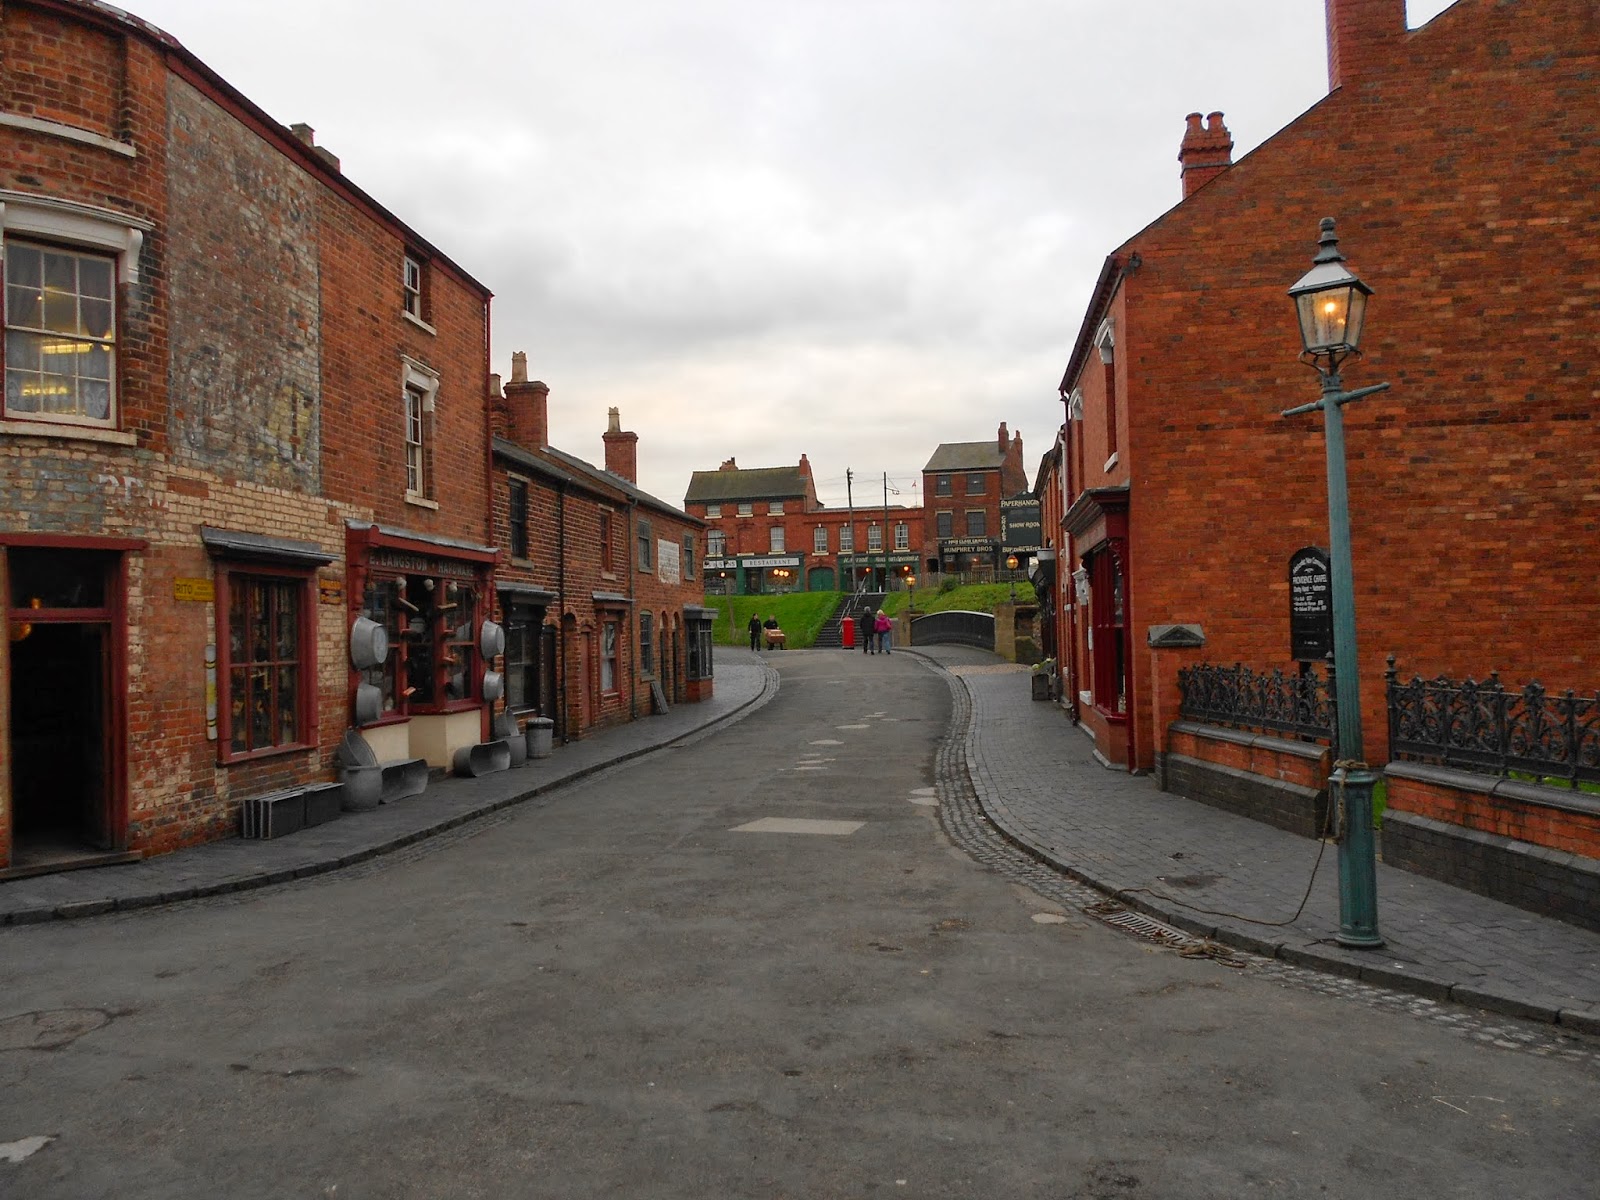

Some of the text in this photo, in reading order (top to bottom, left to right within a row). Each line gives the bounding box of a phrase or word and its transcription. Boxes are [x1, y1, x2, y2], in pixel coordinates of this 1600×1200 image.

[381, 553, 427, 572] LANGSTON
[438, 561, 474, 577] HARDWARE
[1292, 574, 1327, 585] PROVIDENCE CHAPEL
